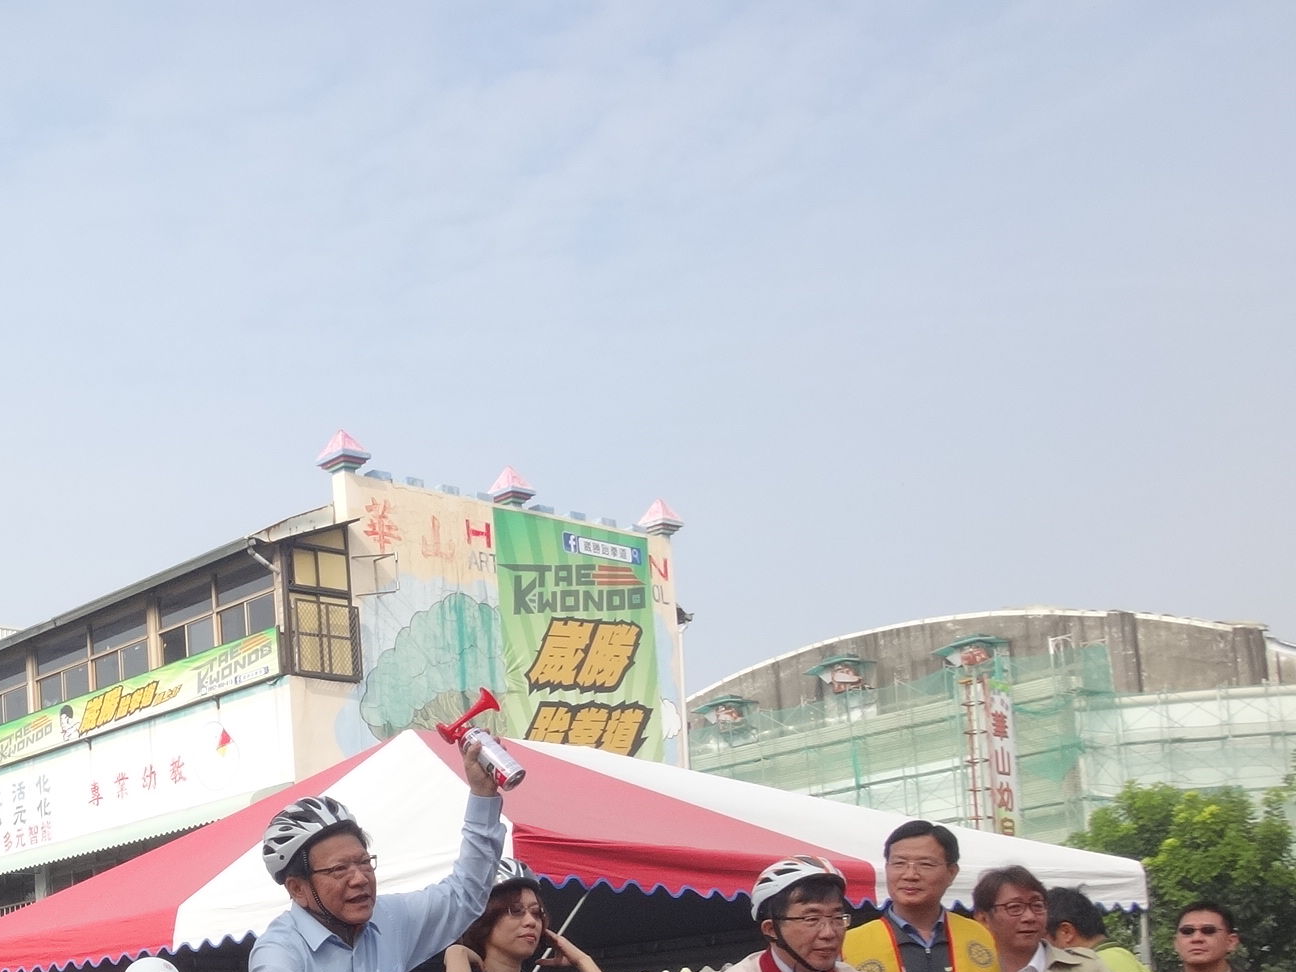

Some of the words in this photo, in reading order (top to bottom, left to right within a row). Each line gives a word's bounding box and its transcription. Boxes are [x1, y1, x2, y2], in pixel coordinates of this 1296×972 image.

[498, 564, 596, 588] TAE
[513, 574, 647, 615] KWONDO
[189, 641, 242, 672] TAE
[88, 755, 188, 807] 專業幼教
